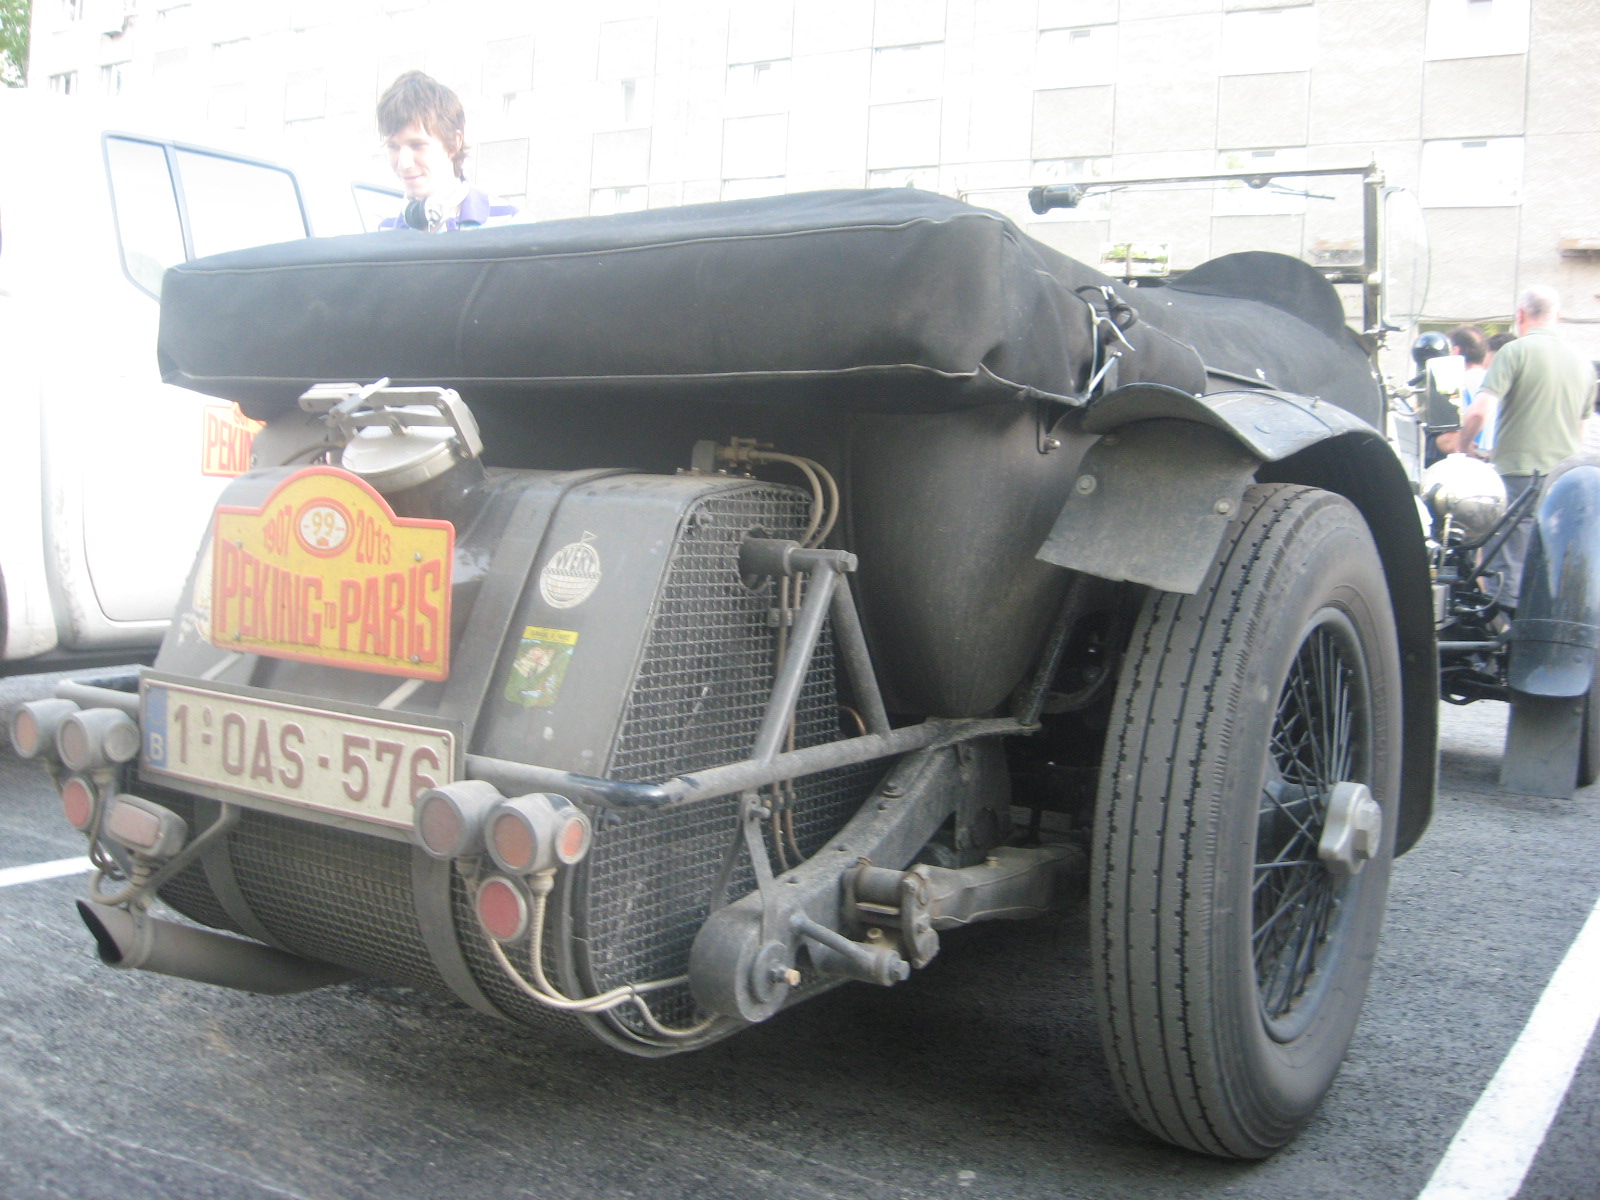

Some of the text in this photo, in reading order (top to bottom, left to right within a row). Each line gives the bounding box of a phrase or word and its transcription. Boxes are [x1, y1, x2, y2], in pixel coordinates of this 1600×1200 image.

[206, 412, 256, 472] PEKIN
[263, 505, 292, 557] 1907
[312, 511, 335, 537] 99
[355, 509, 391, 565] 2013
[219, 538, 442, 664] PEKING TO PARIS
[149, 732, 164, 761] B
